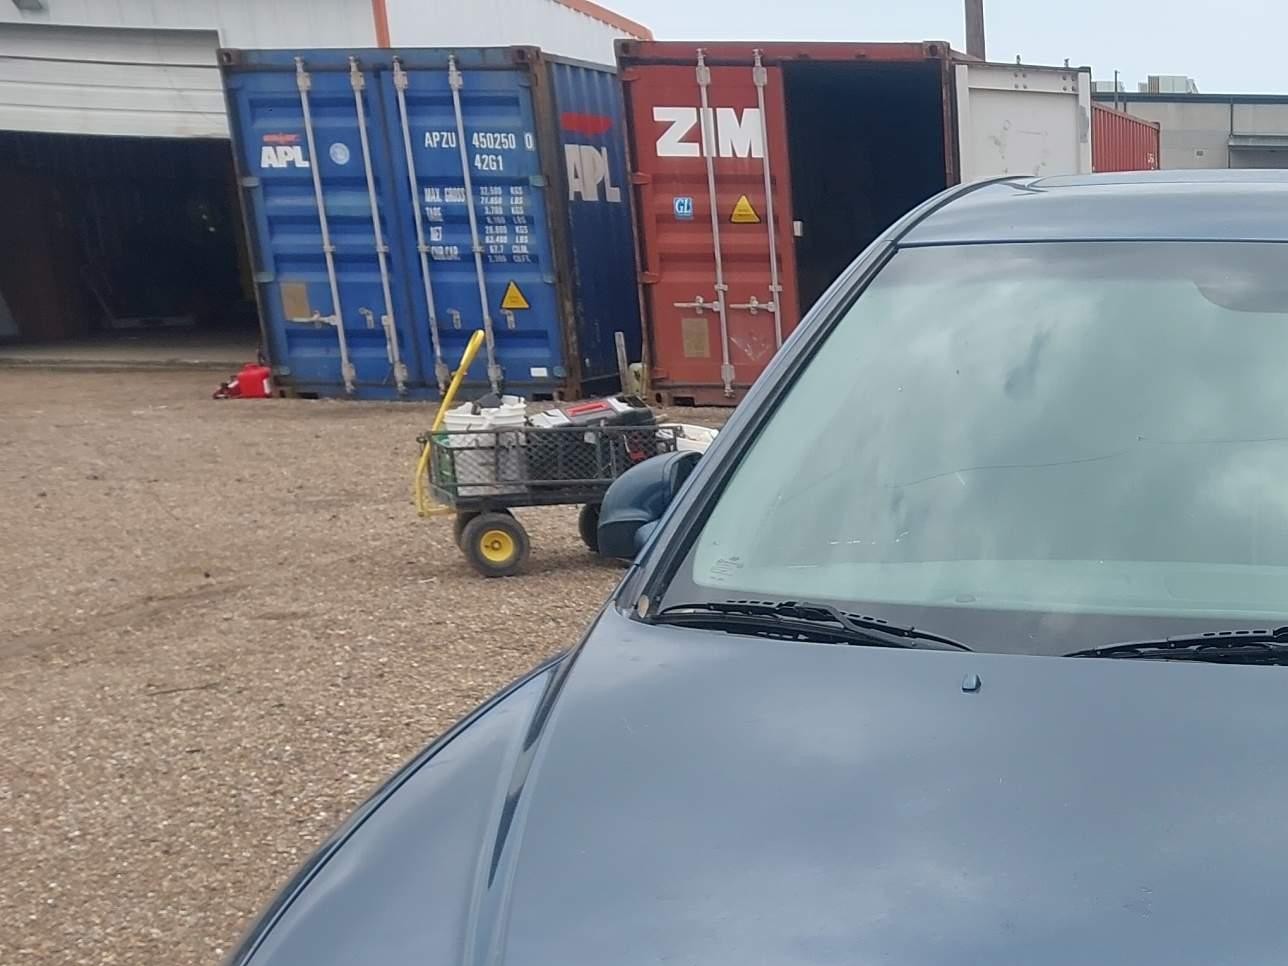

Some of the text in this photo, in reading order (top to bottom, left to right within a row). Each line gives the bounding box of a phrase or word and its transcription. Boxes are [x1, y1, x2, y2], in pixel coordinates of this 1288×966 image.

[424, 131, 457, 149] APZU
[472, 132, 516, 149] 450250
[652, 106, 764, 158] ZIM
[260, 146, 310, 168] APL
[474, 154, 503, 171] 42G1
[563, 144, 621, 203] APL
